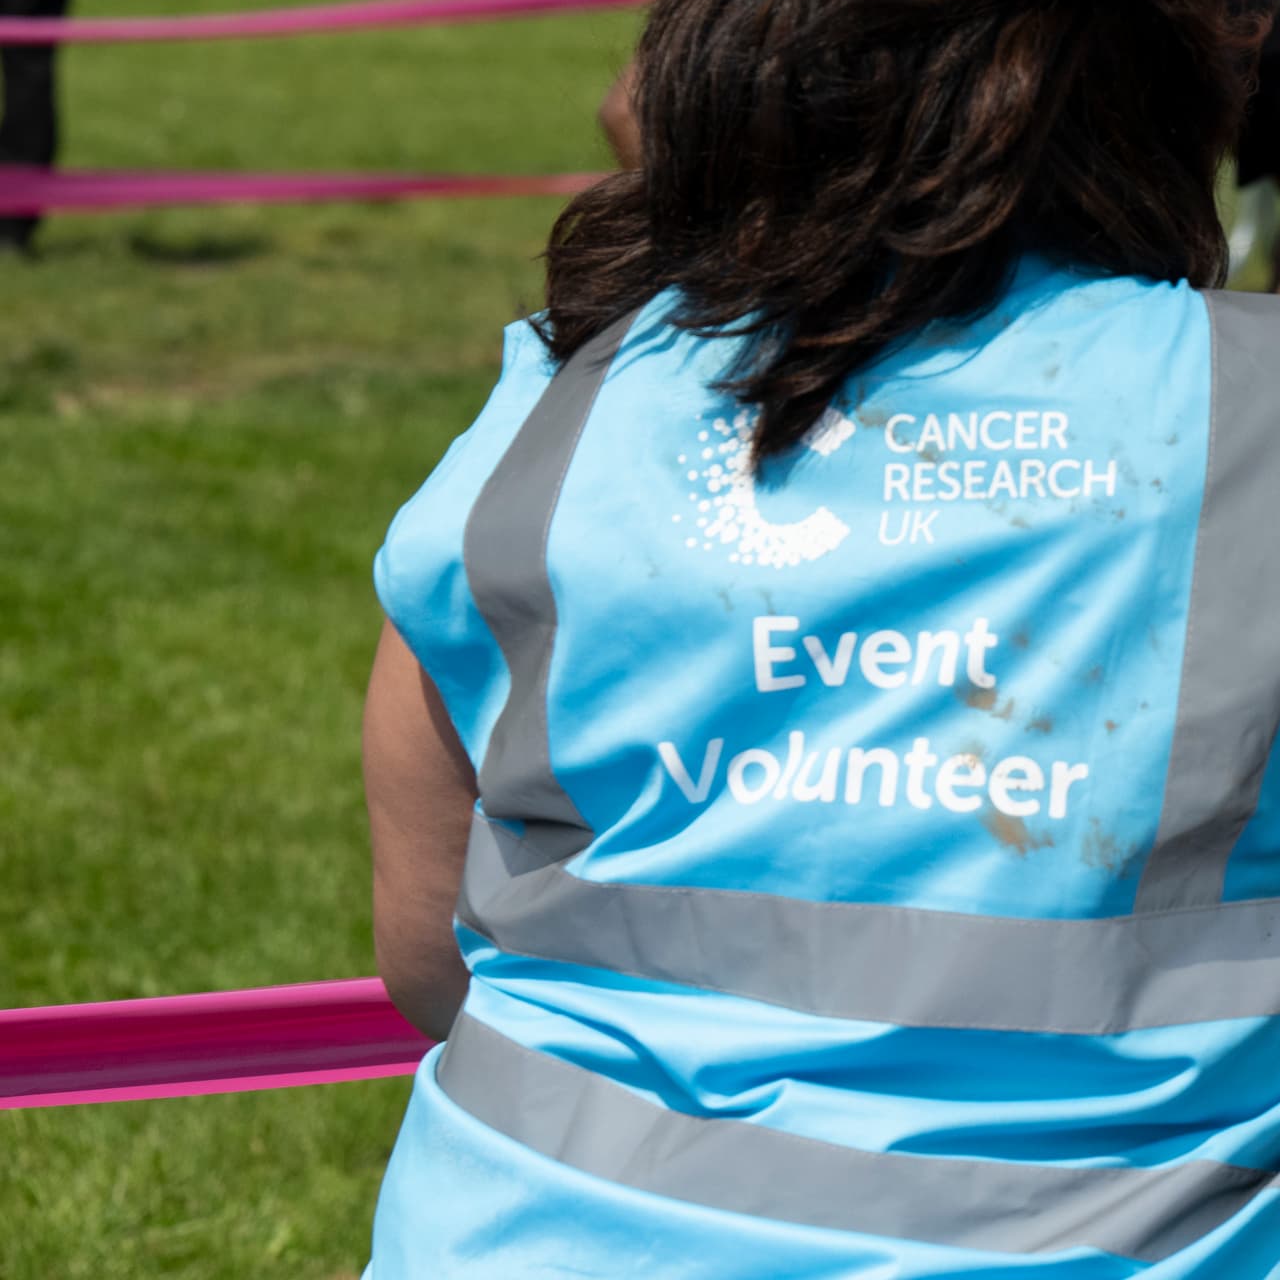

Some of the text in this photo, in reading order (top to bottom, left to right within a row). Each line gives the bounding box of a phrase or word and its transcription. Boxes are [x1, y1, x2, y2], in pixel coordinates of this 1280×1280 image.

[884, 411, 1069, 454] CANCER
[883, 459, 1117, 501] RESEARCH
[877, 509, 941, 545] UK
[752, 615, 998, 692] Event
[657, 730, 1088, 819] Volunteer
